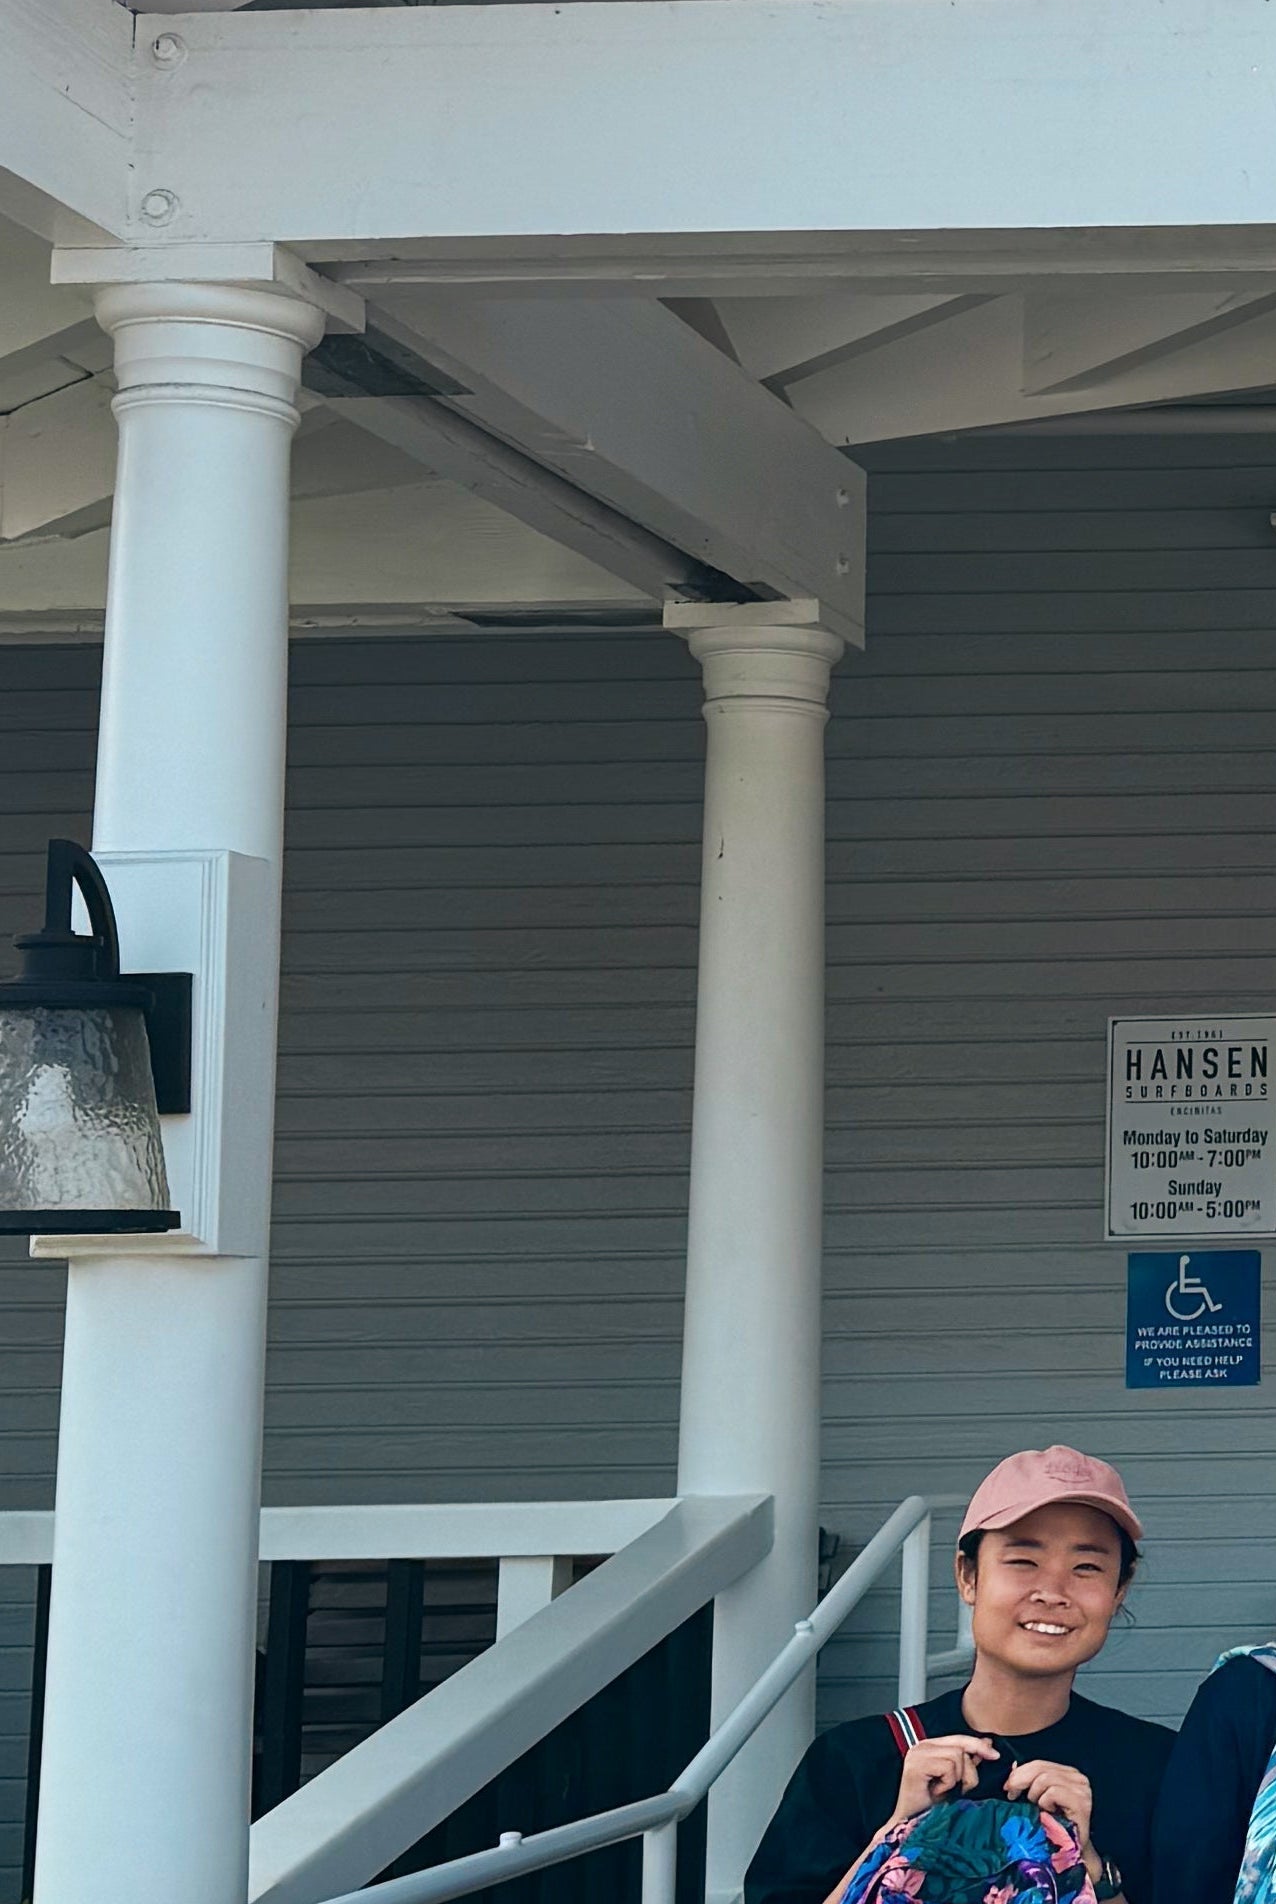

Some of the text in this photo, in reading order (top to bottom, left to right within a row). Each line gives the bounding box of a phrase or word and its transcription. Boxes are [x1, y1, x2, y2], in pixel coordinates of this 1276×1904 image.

[1126, 1046, 1267, 1081] HANSEN
[1126, 1083, 1267, 1098] SURFBOARDS
[1123, 1128, 1268, 1147] Monday to Saturday
[1168, 1179, 1221, 1197] Sunday
[1138, 1324, 1251, 1336] WE ARE PLEASED TO
[1135, 1338, 1253, 1350] PROVIDE ASSISTANCE
[1157, 1357, 1179, 1366] YOU
[1182, 1356, 1212, 1366] NEED
[1215, 1355, 1243, 1365] HELP
[1159, 1369, 1228, 1380] PLEASE ASK
